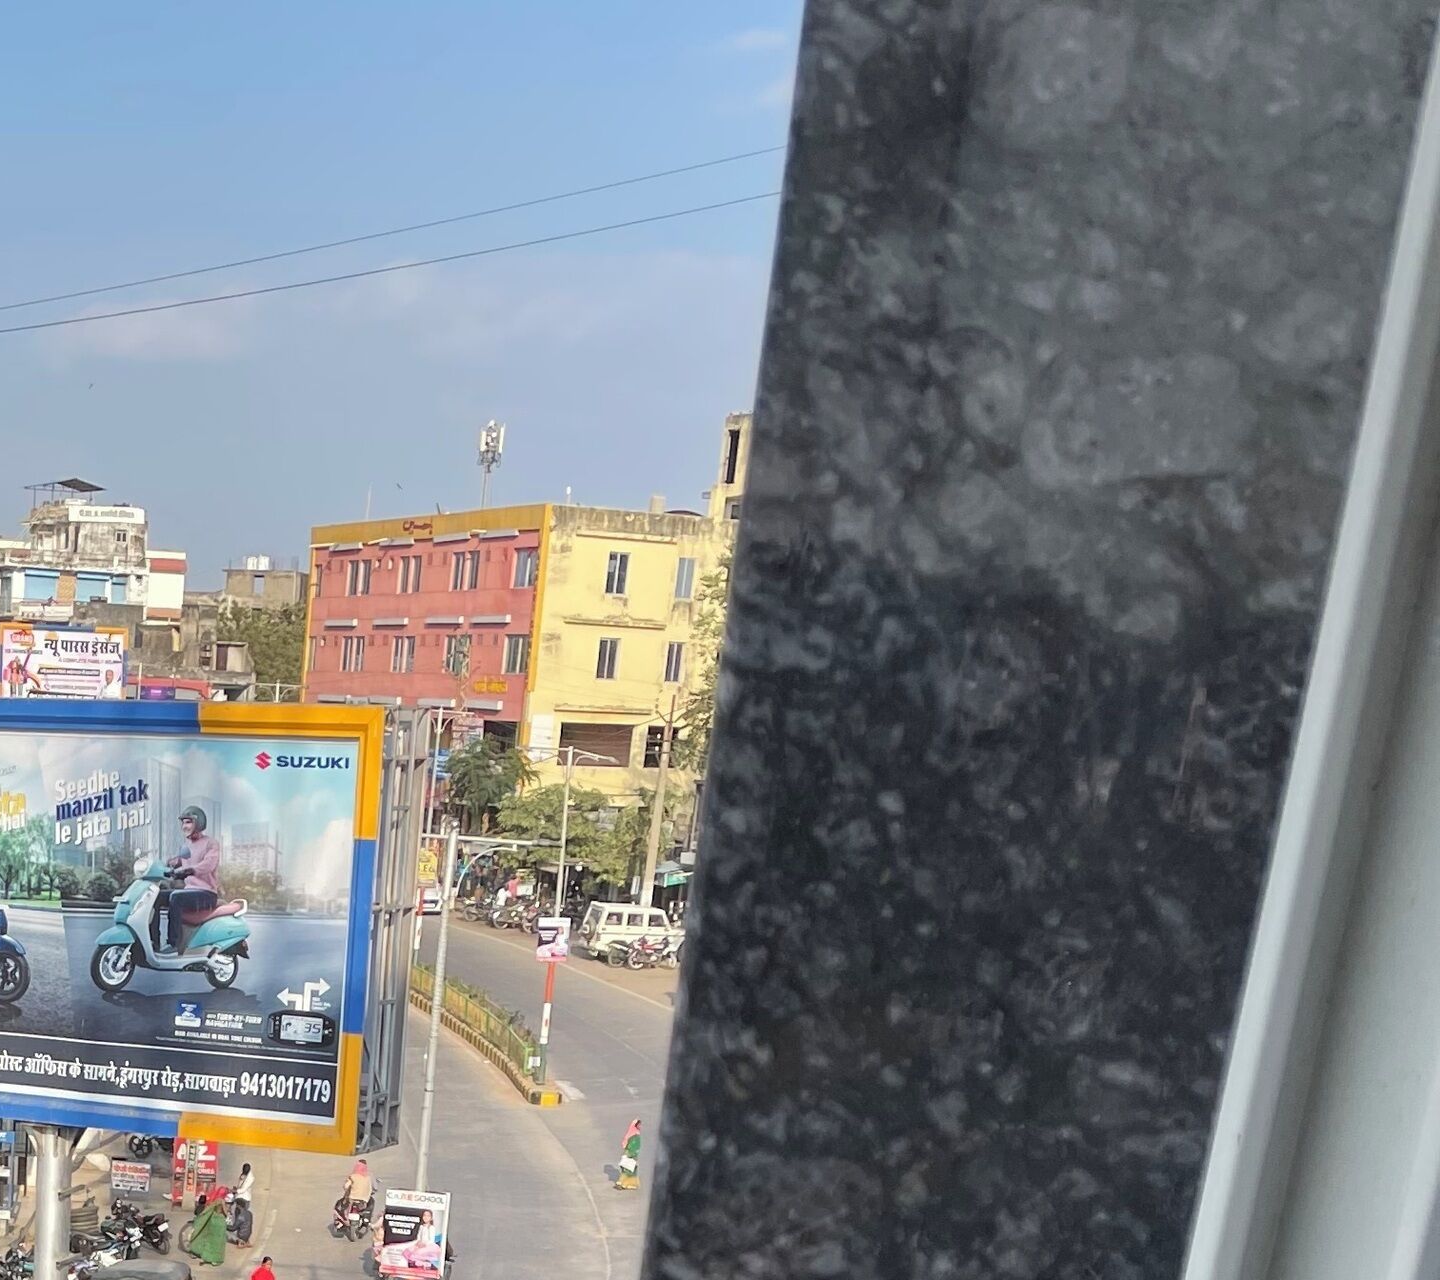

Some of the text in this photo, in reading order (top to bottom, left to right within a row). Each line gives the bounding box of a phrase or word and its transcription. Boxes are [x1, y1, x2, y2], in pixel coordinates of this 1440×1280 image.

[61, 639, 89, 654] पारस
[276, 755, 350, 770] SUZUKI
[55, 768, 121, 802] Seedhe
[55, 778, 150, 822] manzil tak
[55, 820, 72, 846] le
[74, 812, 111, 847] jata
[25, 1052, 68, 1077] ऑफिस
[68, 1057, 83, 1079] के
[240, 1071, 332, 1104] 9413017179
